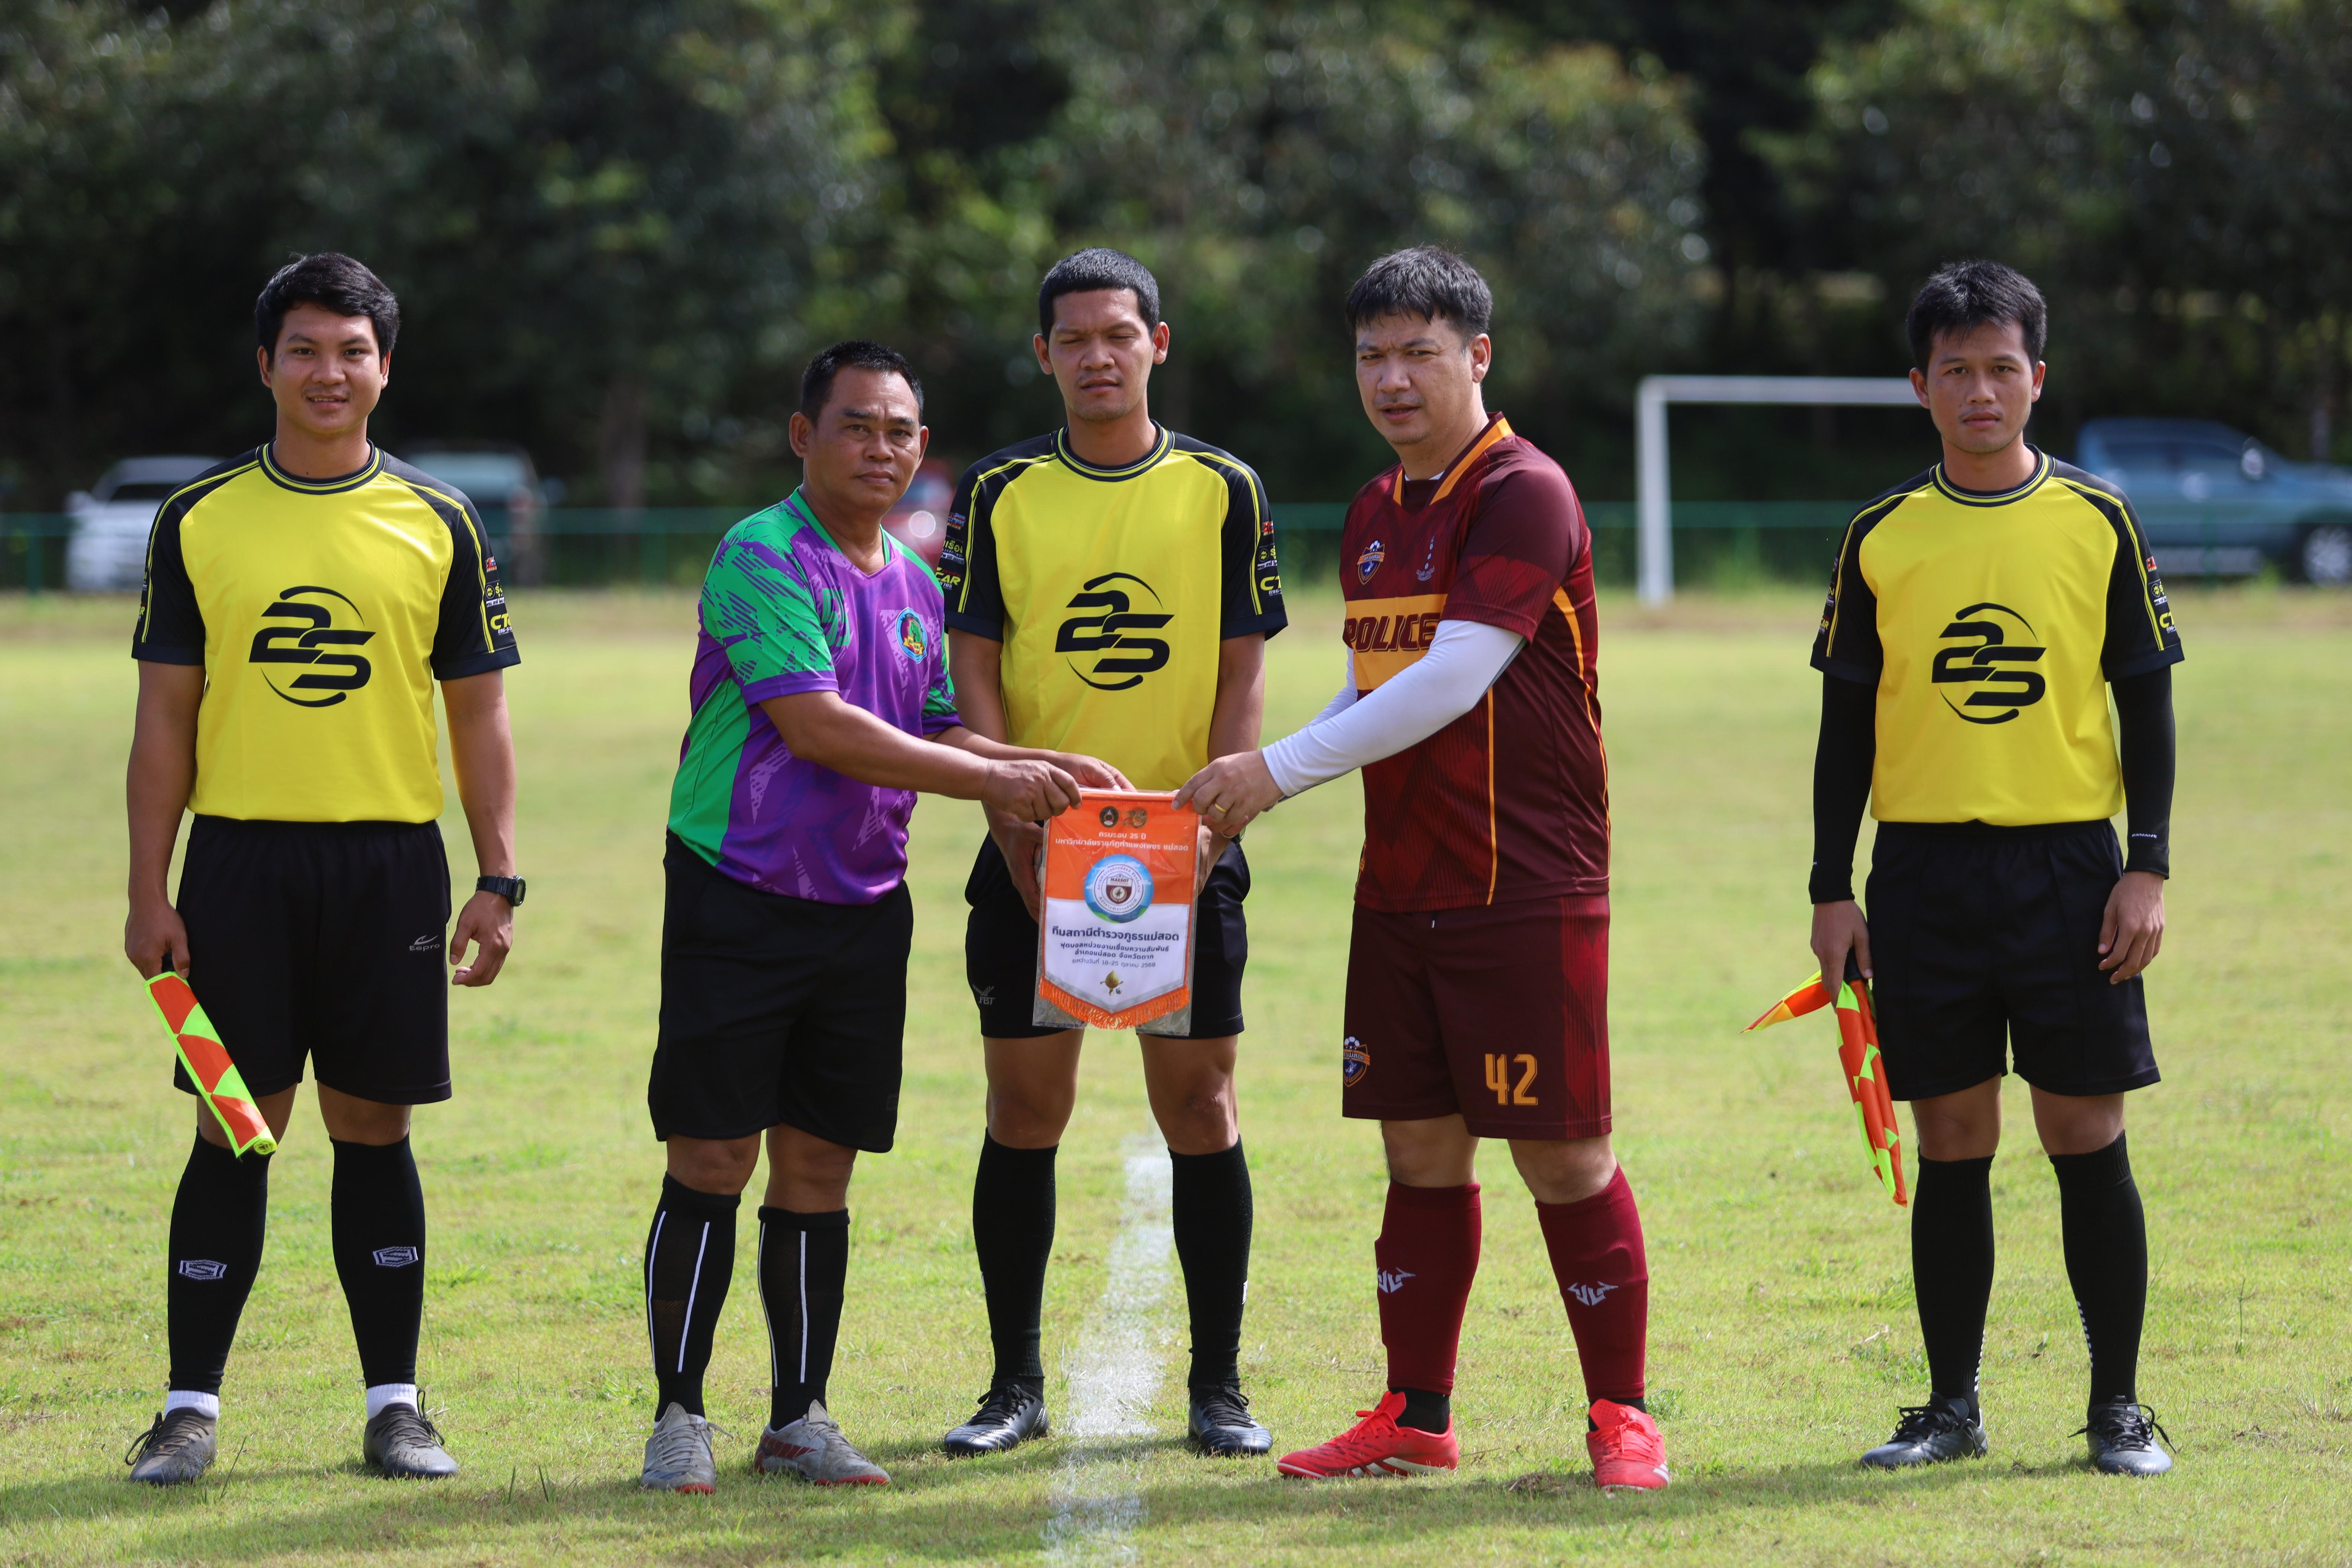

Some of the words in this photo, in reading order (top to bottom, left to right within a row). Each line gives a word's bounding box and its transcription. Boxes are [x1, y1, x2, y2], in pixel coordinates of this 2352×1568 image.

[1344, 612, 1441, 653] POLICE
[1141, 832, 1147, 840] ปี
[1163, 843, 1188, 851] แม่สอด
[1052, 925, 1179, 943] ทีมสถานีตำรวจภูธรแม่สอด
[1075, 948, 1116, 958] อำเภอแม่สอด
[1485, 1054, 1538, 1105] 42
